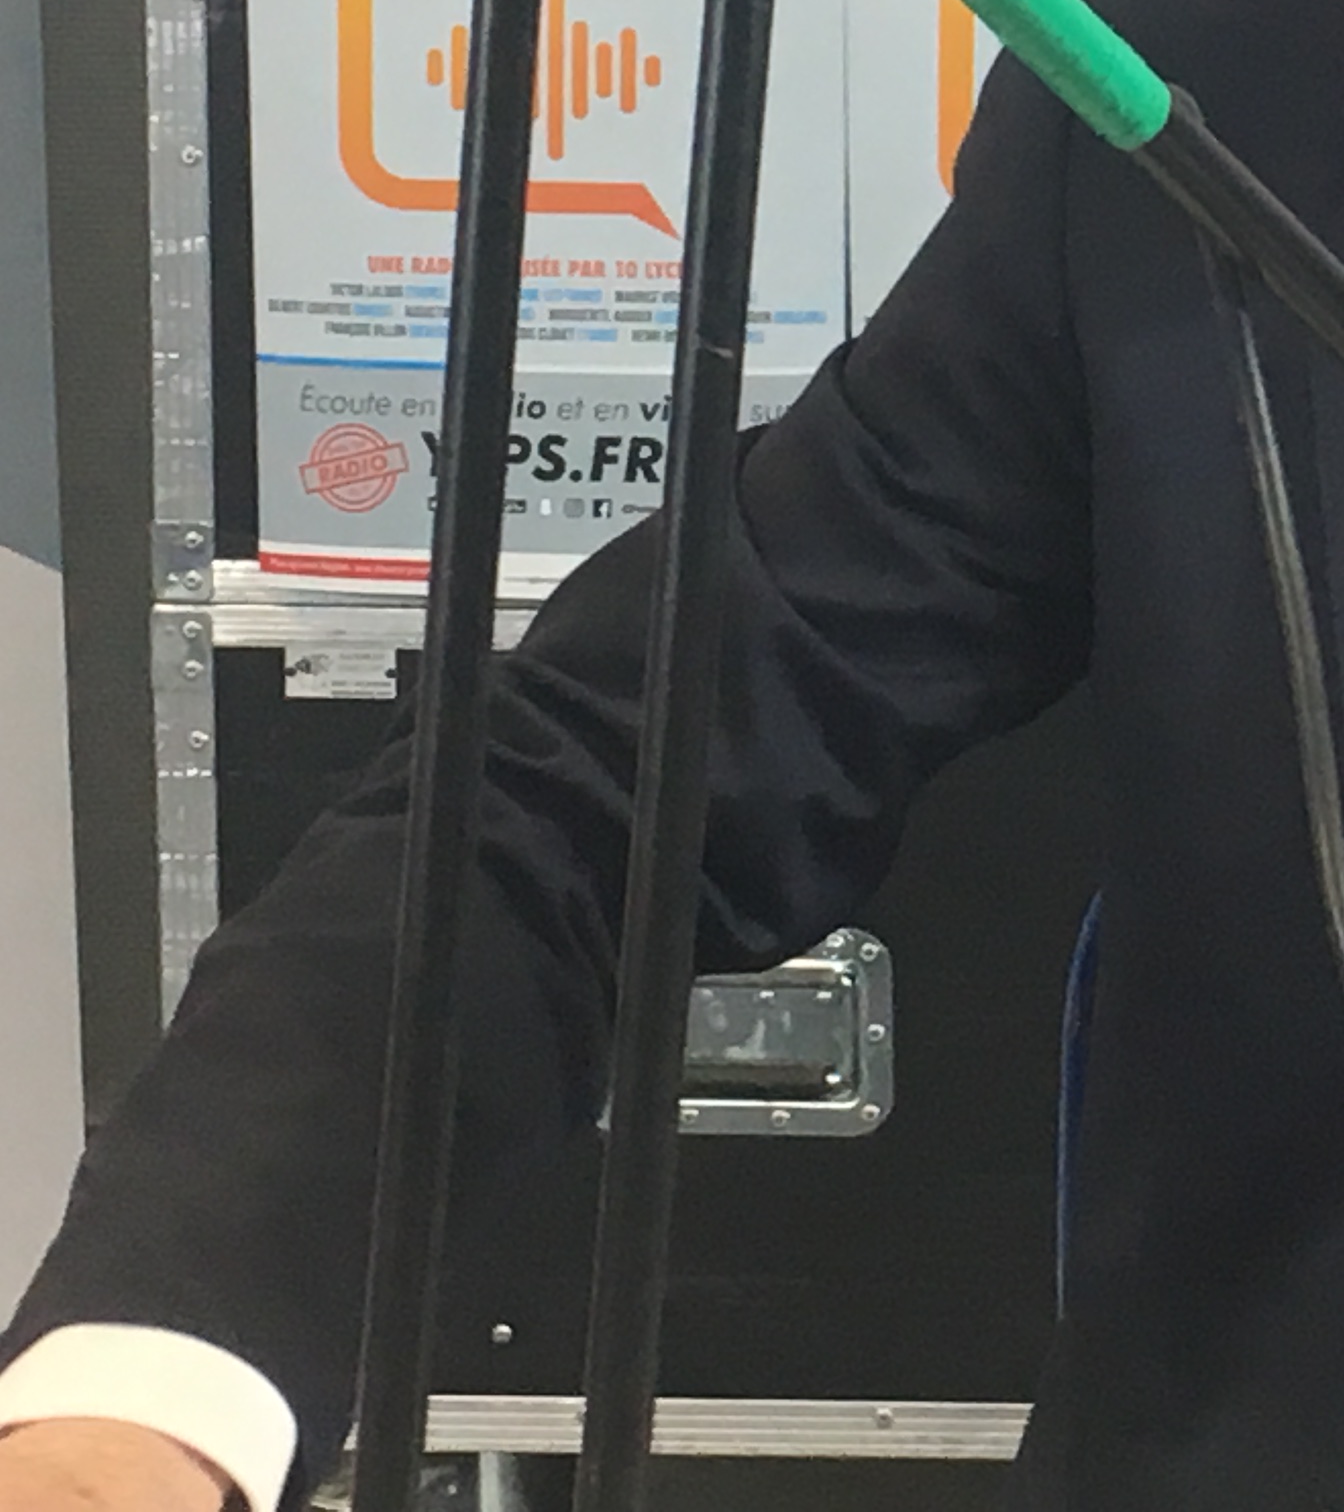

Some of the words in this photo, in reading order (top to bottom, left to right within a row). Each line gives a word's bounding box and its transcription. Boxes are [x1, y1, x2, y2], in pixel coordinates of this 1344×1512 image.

[300, 383, 392, 416] Écoute
[401, 398, 436, 417] en
[557, 396, 584, 421] et
[594, 401, 630, 422] en
[317, 453, 388, 484] RADIO
